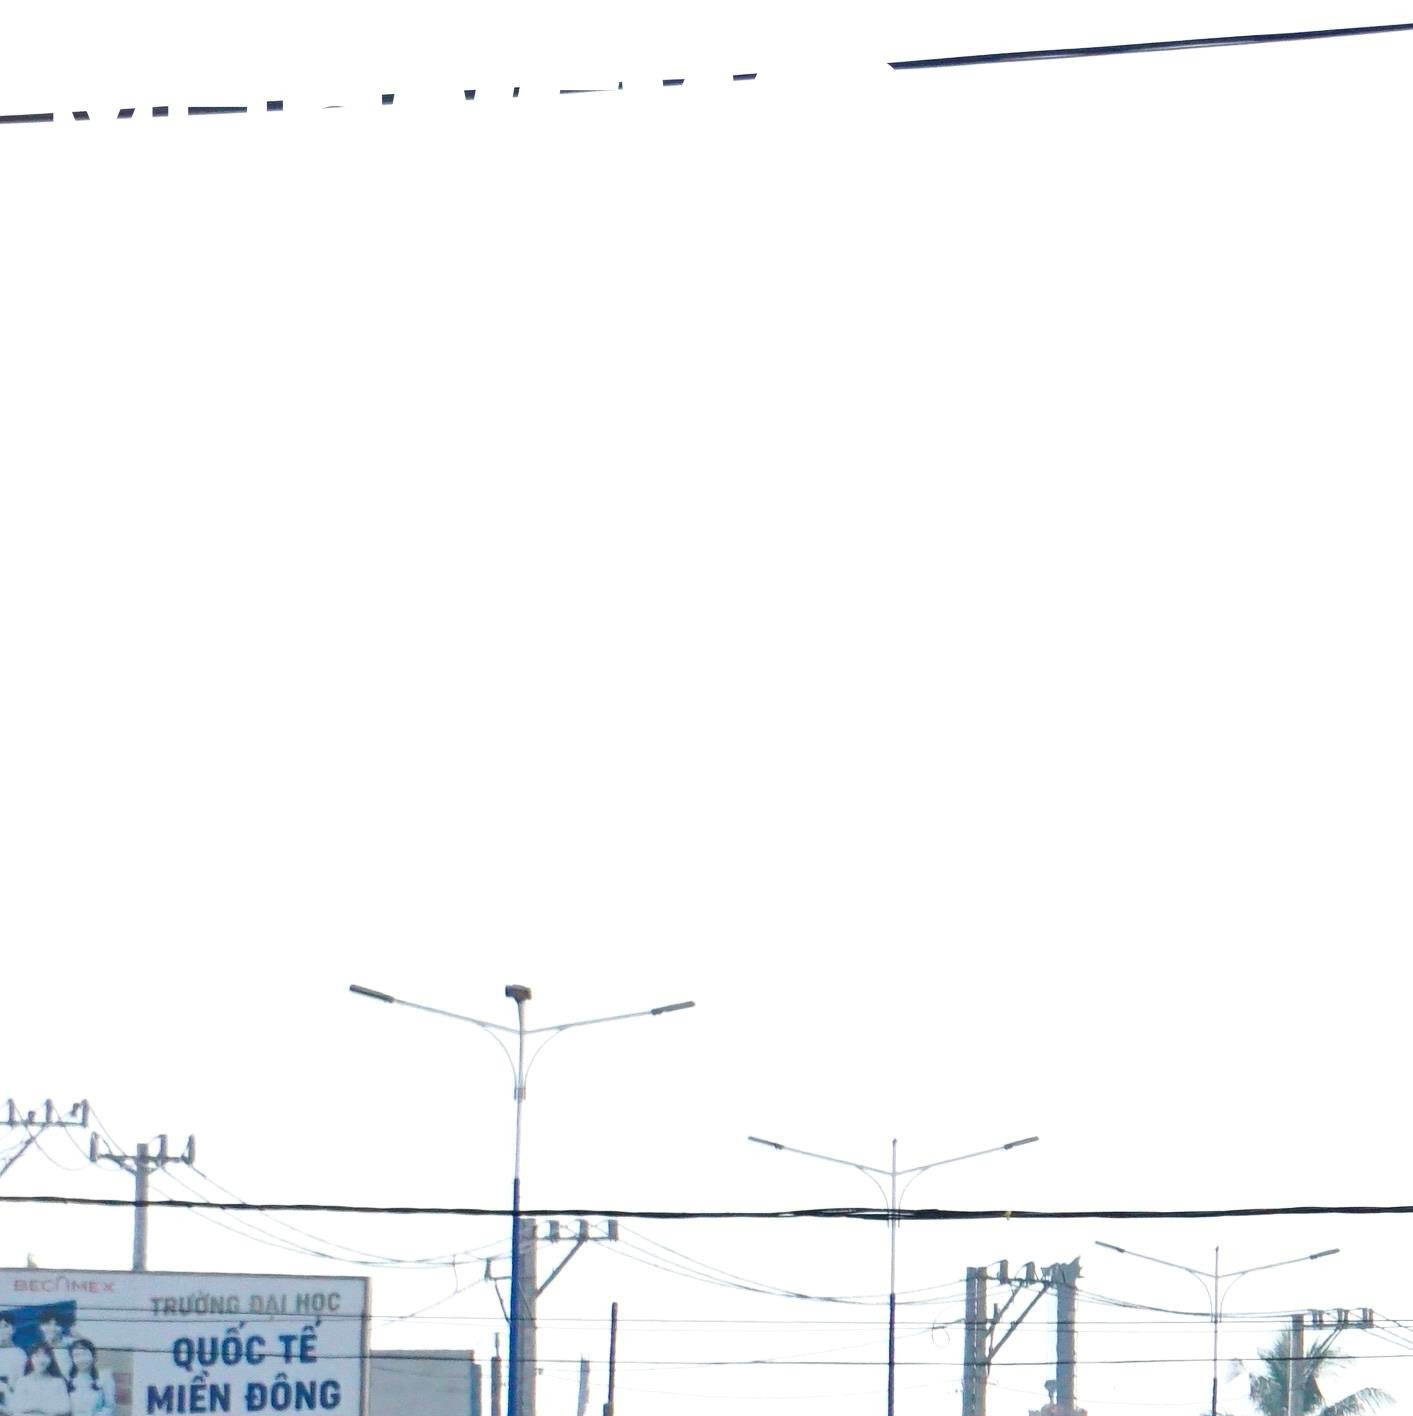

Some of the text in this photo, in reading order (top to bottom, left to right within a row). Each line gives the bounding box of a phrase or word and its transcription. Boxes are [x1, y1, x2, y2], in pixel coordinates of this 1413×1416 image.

[151, 1290, 342, 1321] TRƯỜNG ĐẠI HỌC
[173, 1315, 322, 1372] QUỐC TẾ
[147, 1370, 341, 1414] MIỀN ĐÔNG
